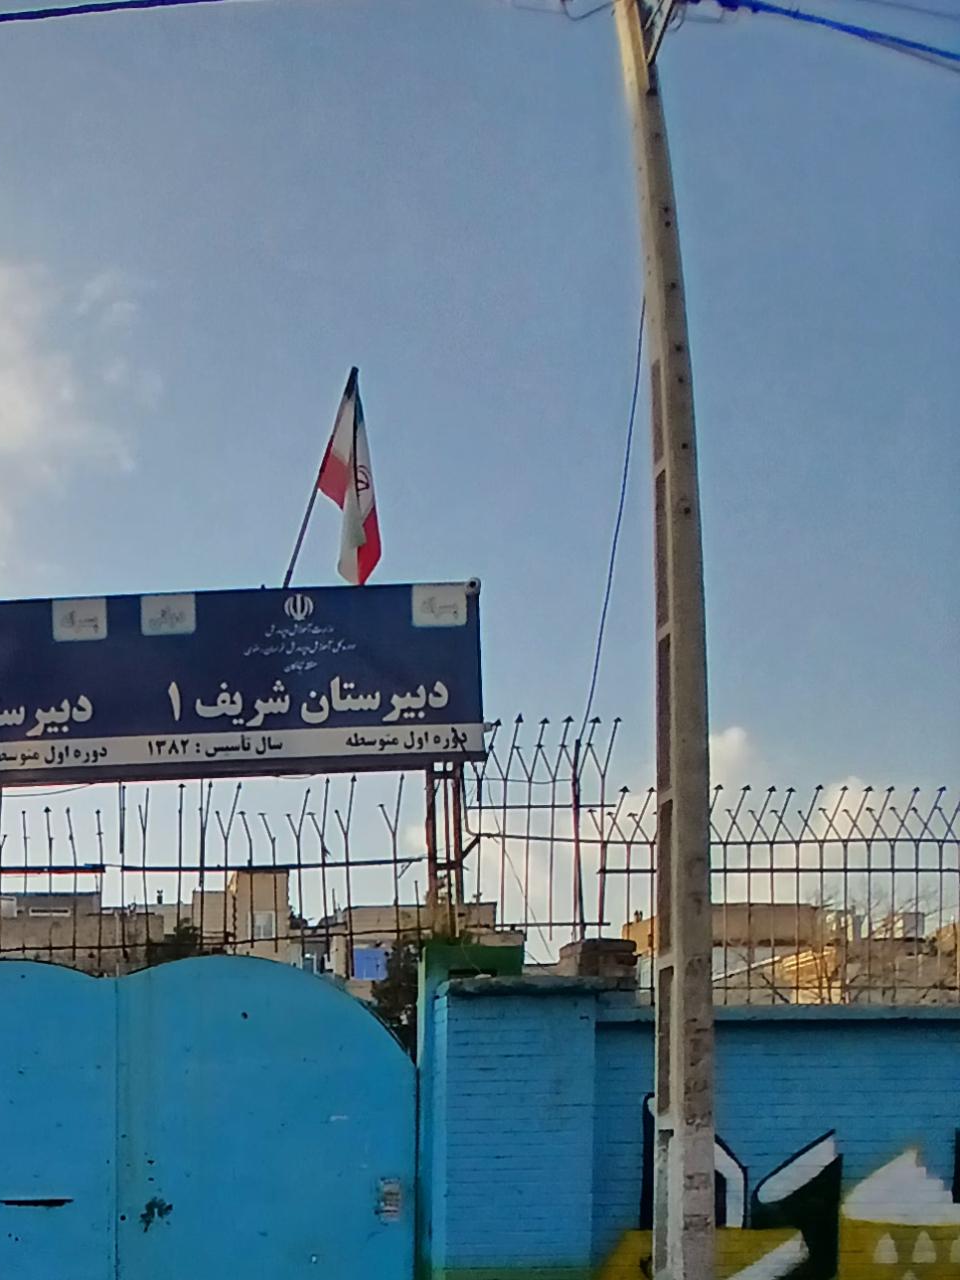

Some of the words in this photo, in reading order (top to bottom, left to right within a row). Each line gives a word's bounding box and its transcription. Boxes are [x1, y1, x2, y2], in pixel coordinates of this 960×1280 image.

[167, 681, 182, 722] ۱
[195, 680, 290, 728] شریف
[300, 676, 449, 724] دبیرستان
[255, 736, 284, 755] سال
[345, 732, 400, 751] متوسطه
[403, 731, 429, 750] اول
[433, 732, 467, 750] دوره
[44, 745, 70, 765] اول
[73, 746, 108, 764] دوره
